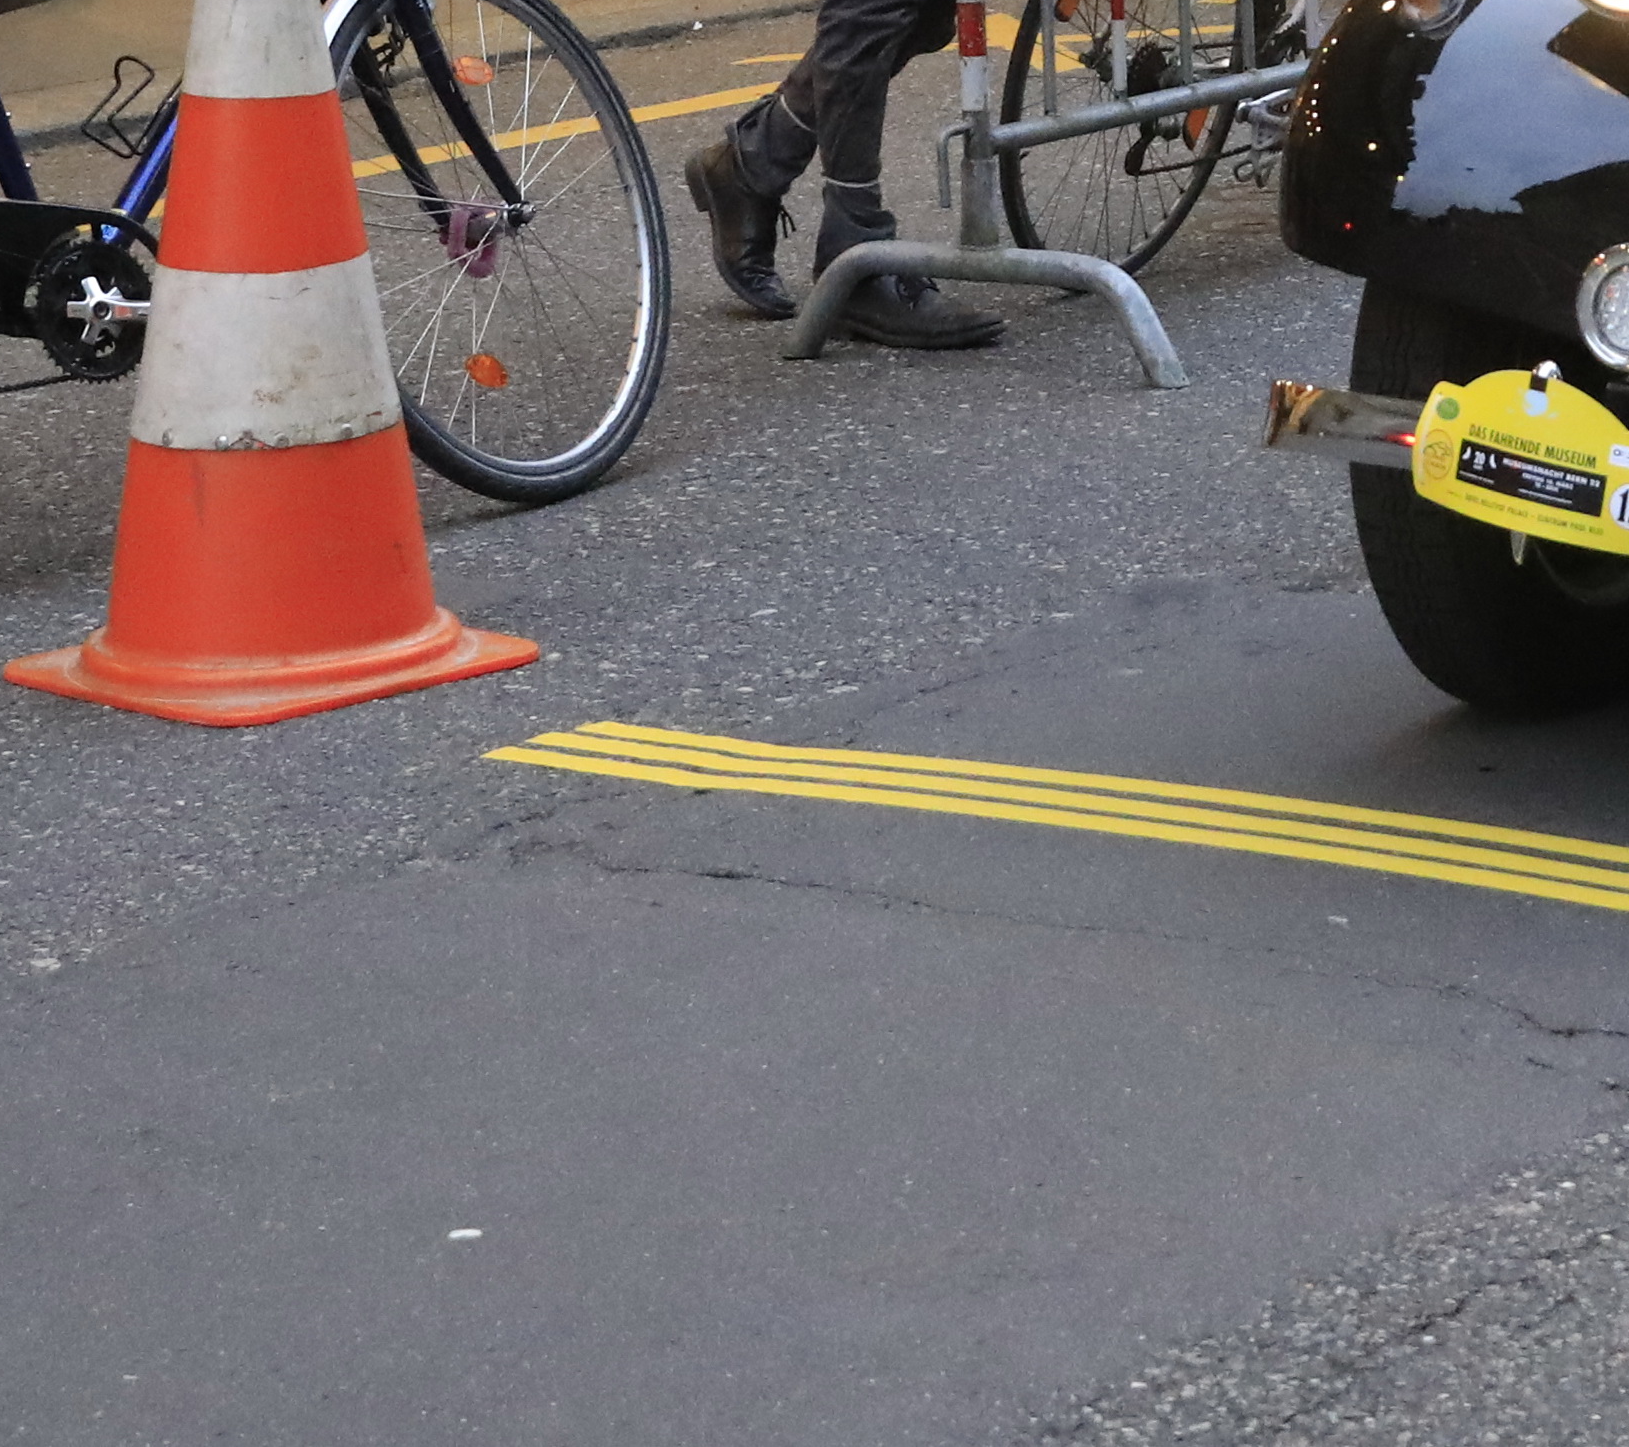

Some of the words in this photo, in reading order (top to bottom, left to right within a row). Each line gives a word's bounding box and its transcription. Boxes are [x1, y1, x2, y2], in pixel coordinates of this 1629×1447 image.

[1469, 424, 1488, 442] DAS
[1489, 428, 1541, 455] FAHRENDE
[1544, 445, 1597, 469] MUSEUM
